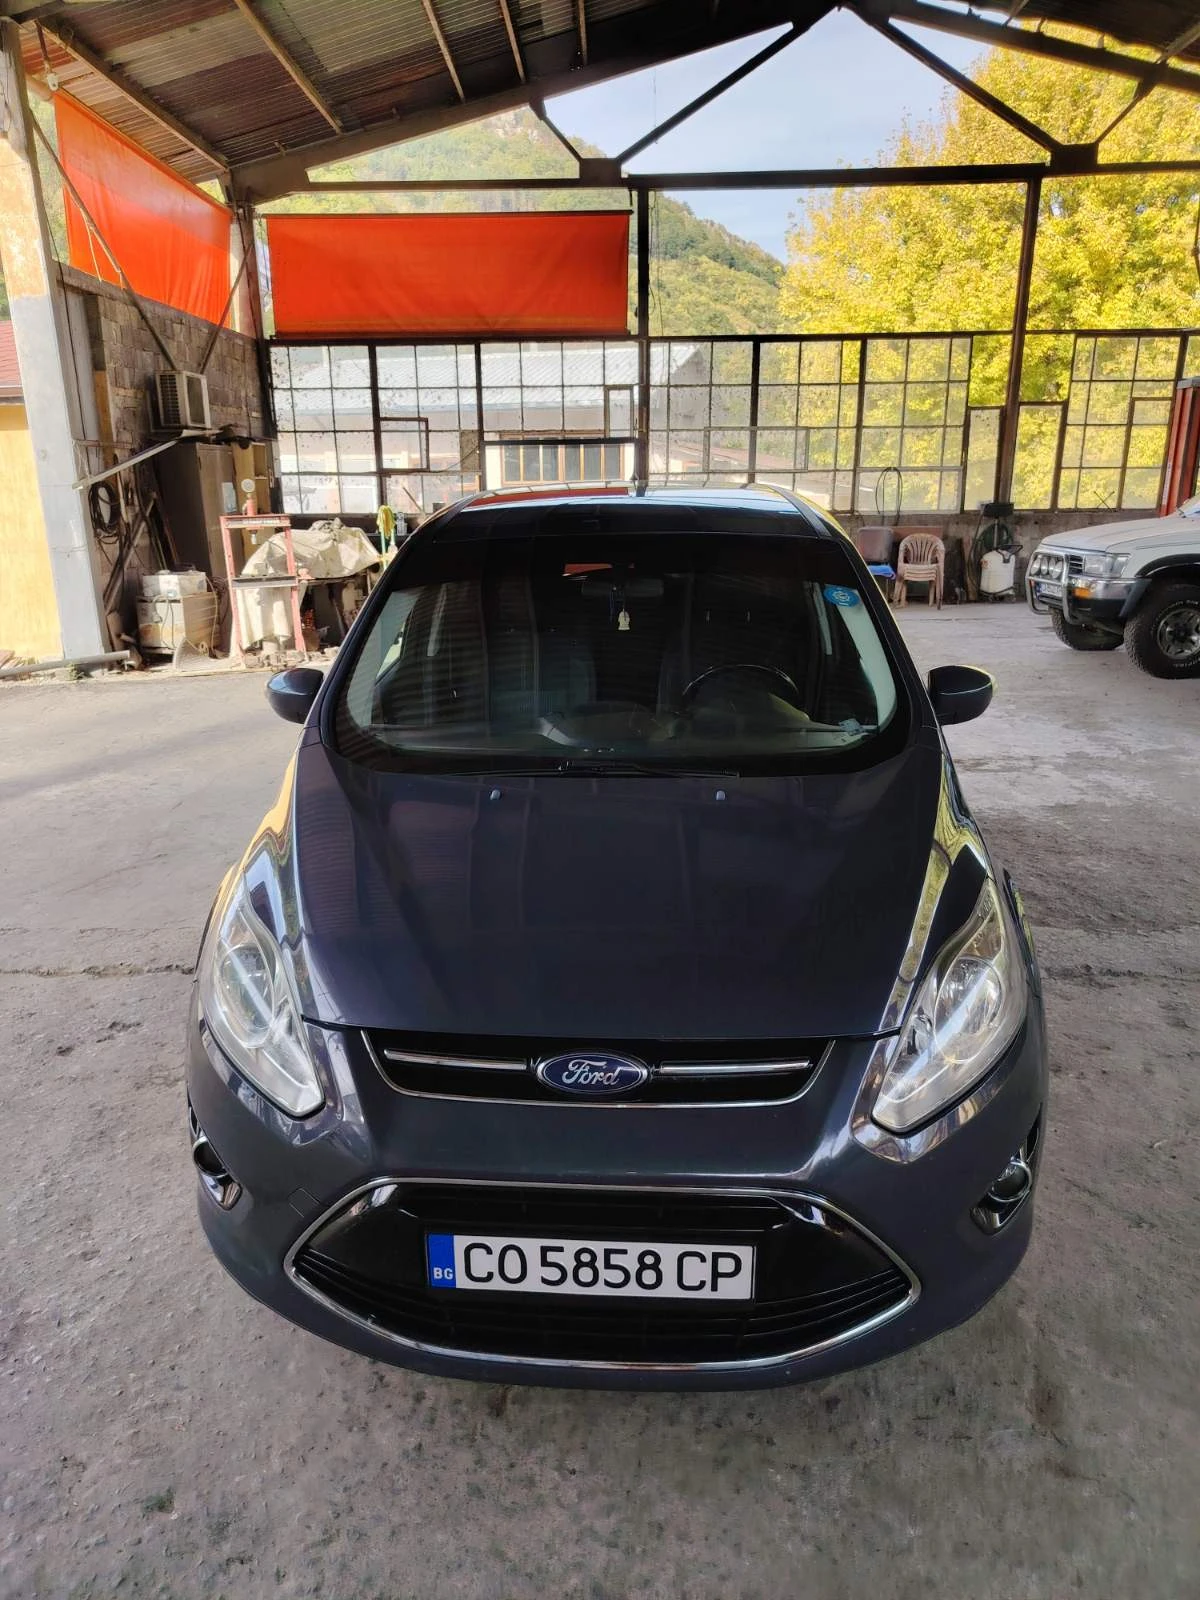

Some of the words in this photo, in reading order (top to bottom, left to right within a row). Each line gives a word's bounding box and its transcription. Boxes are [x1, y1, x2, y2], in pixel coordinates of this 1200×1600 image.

[562, 1059, 620, 1086] Ford
[433, 1267, 454, 1280] BG
[463, 1242, 528, 1285] CO
[539, 1245, 664, 1291] 5858
[676, 1250, 743, 1293] CP
